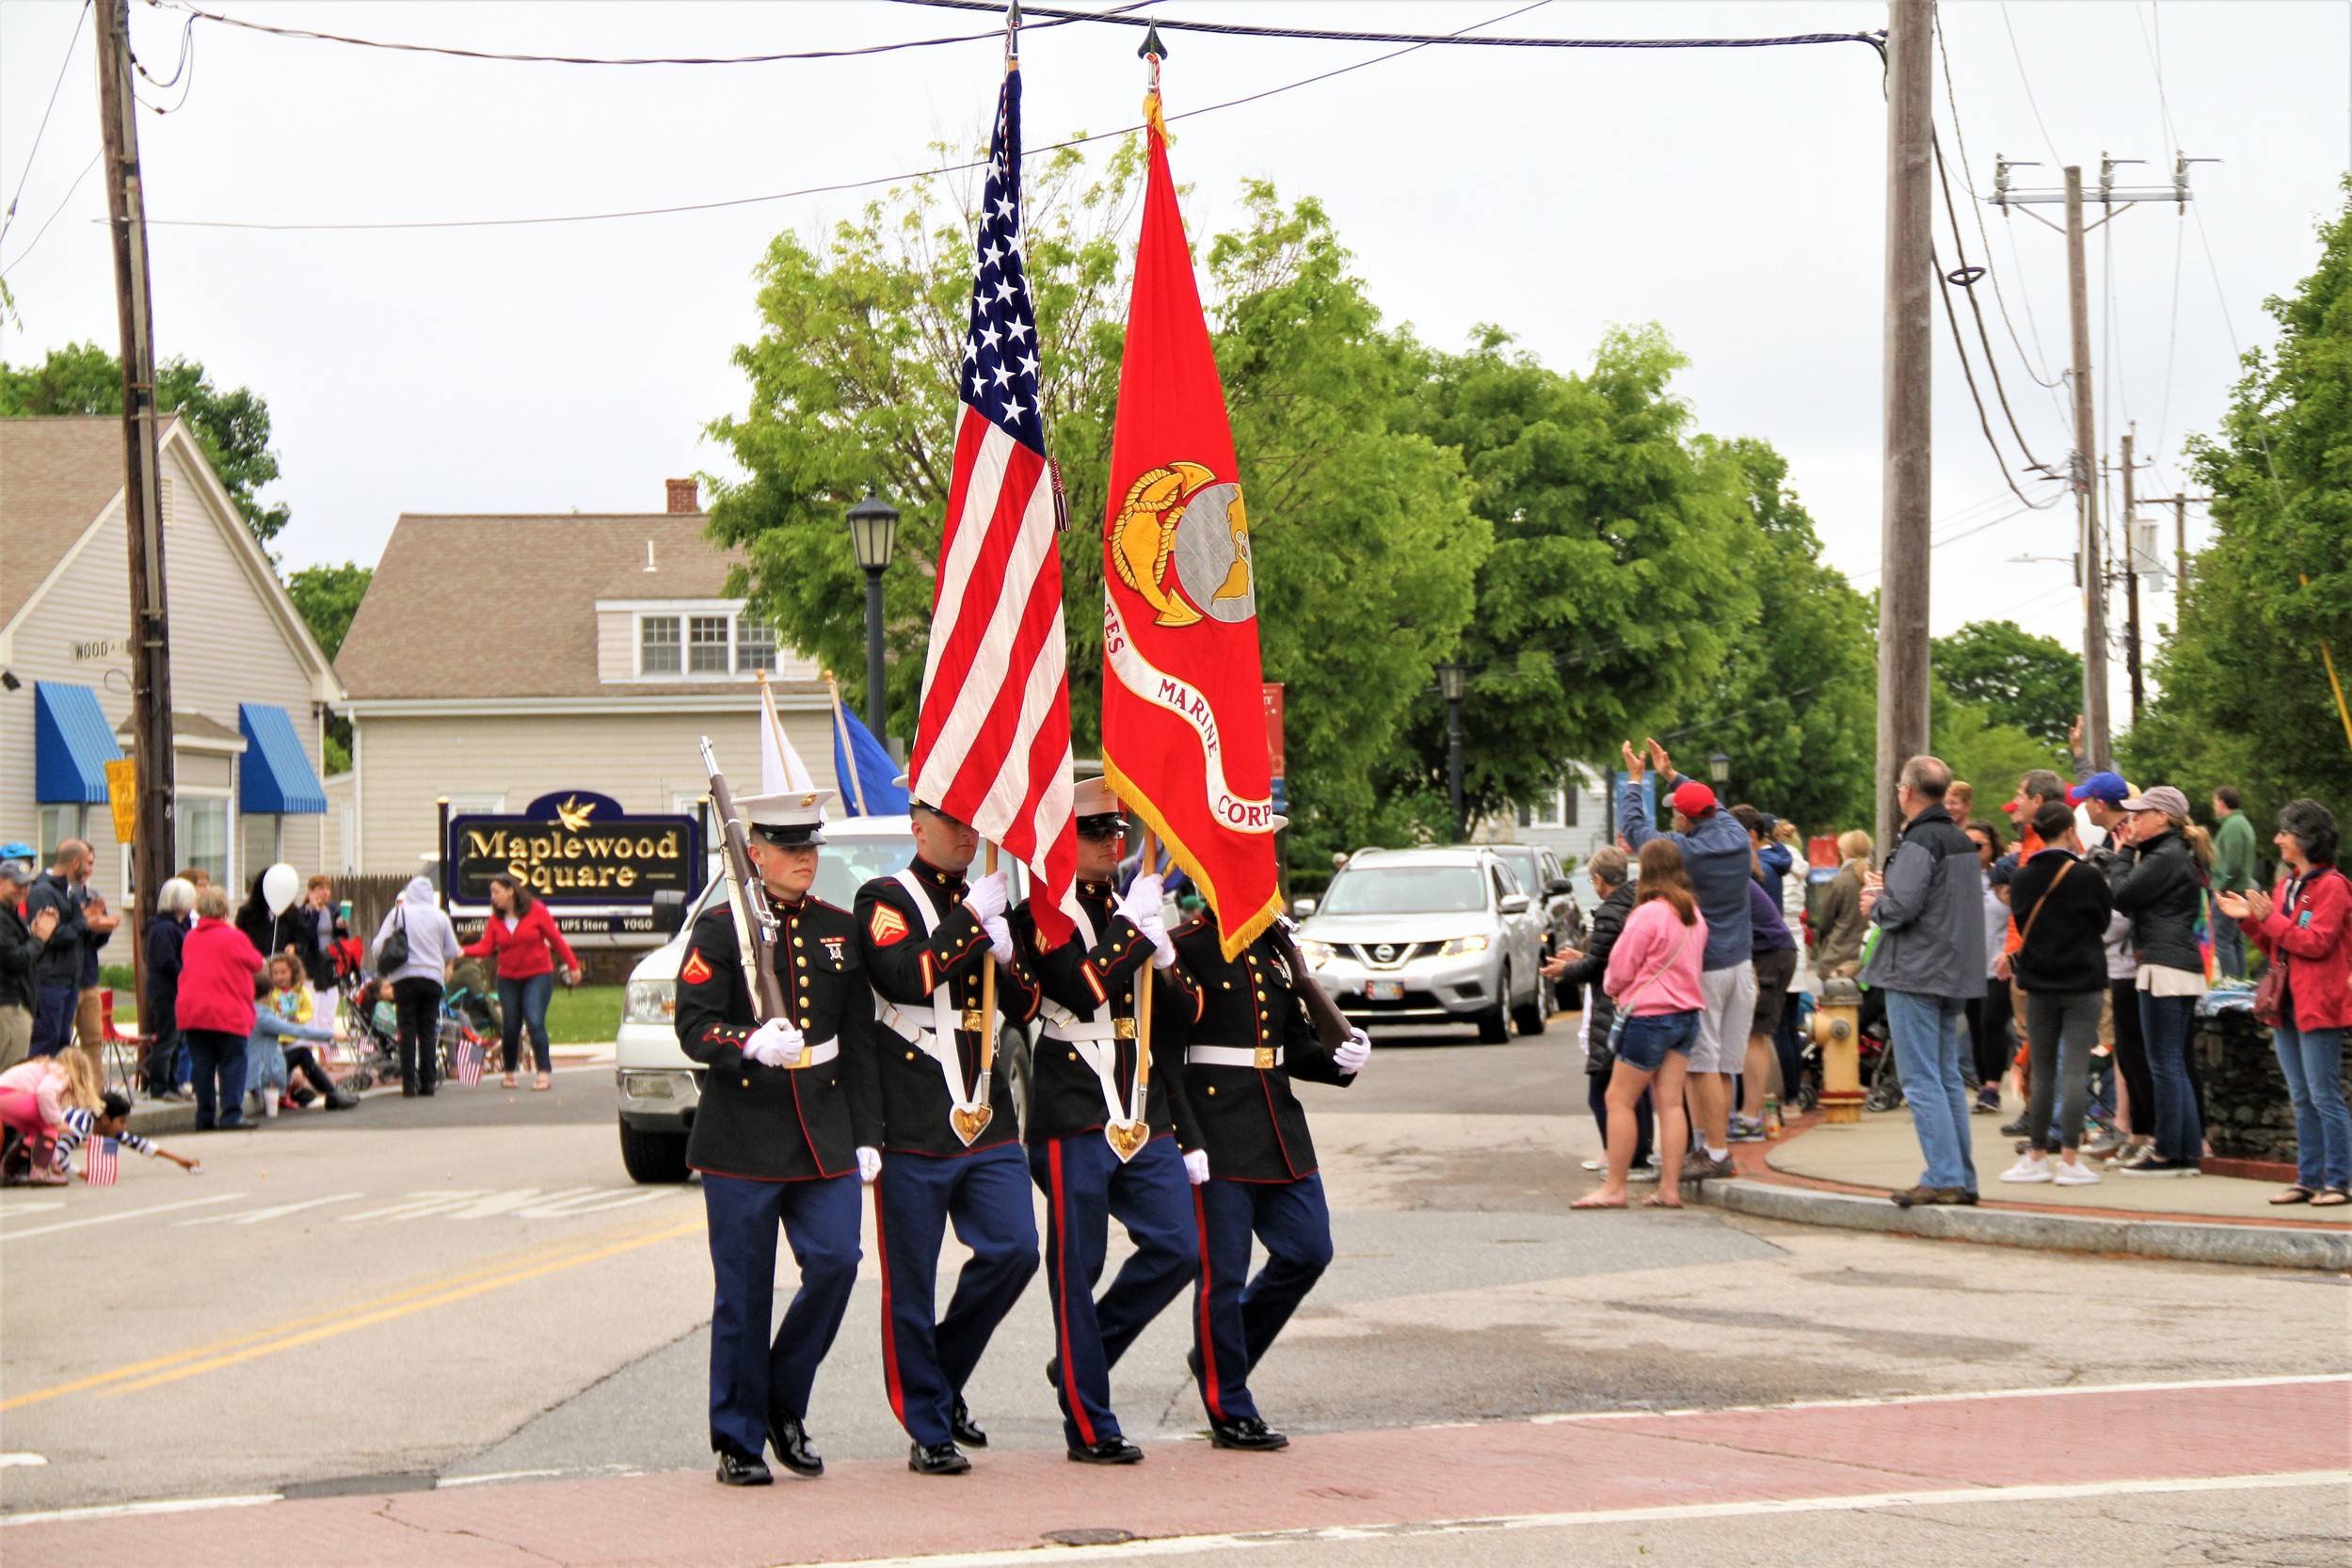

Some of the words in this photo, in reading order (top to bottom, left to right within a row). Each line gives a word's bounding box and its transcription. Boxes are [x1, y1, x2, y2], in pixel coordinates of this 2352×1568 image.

[75, 641, 108, 660] WOOD
[1158, 679, 1218, 758] MARINE
[468, 830, 679, 865] Maplewood
[507, 859, 637, 894] Square
[560, 918, 581, 932] UPS
[582, 919, 610, 932] Store
[622, 917, 653, 931] YOGO
